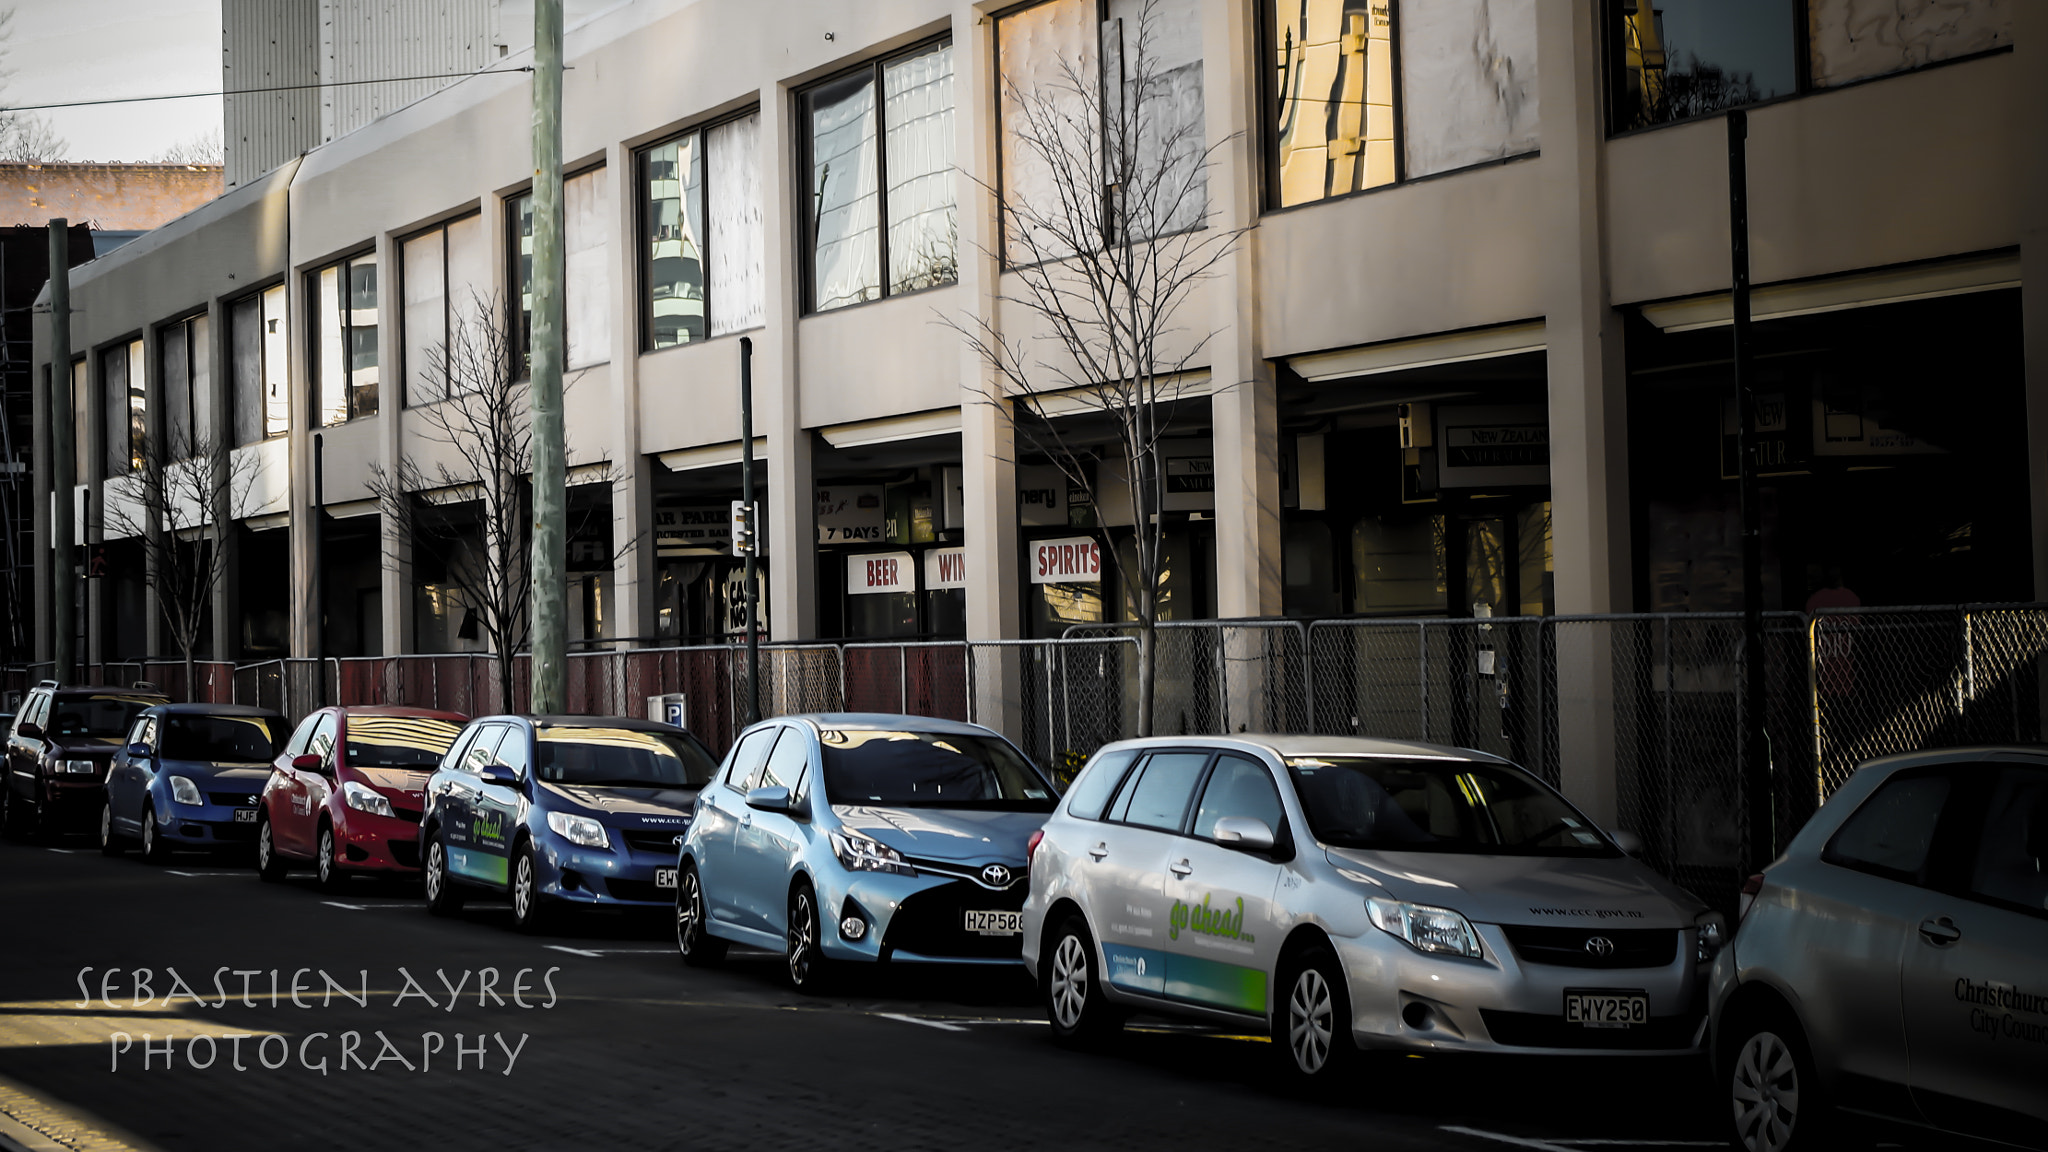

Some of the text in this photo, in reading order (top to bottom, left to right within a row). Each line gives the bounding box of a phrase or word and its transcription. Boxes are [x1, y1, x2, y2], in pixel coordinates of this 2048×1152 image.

[1472, 428, 1548, 443] NEW ZEALAN
[1189, 461, 1211, 473] NEW
[1177, 476, 1214, 489] NATUR
[1021, 488, 1055, 508] nery
[656, 511, 729, 525] AR PARK
[827, 527, 879, 539] 7 DAYS
[938, 553, 966, 583] WIN
[1038, 543, 1100, 577] SPIRITS
[866, 558, 899, 587] BEER
[668, 705, 681, 722] P
[236, 811, 255, 821] HJF
[658, 872, 678, 886] EW
[1170, 899, 1189, 941] go
[1529, 907, 1645, 919] www.ccc.govt.nz
[1954, 977, 2048, 1016] Christchurc
[1568, 998, 1644, 1021] EWY250
[1970, 1007, 2048, 1046] City Counc
